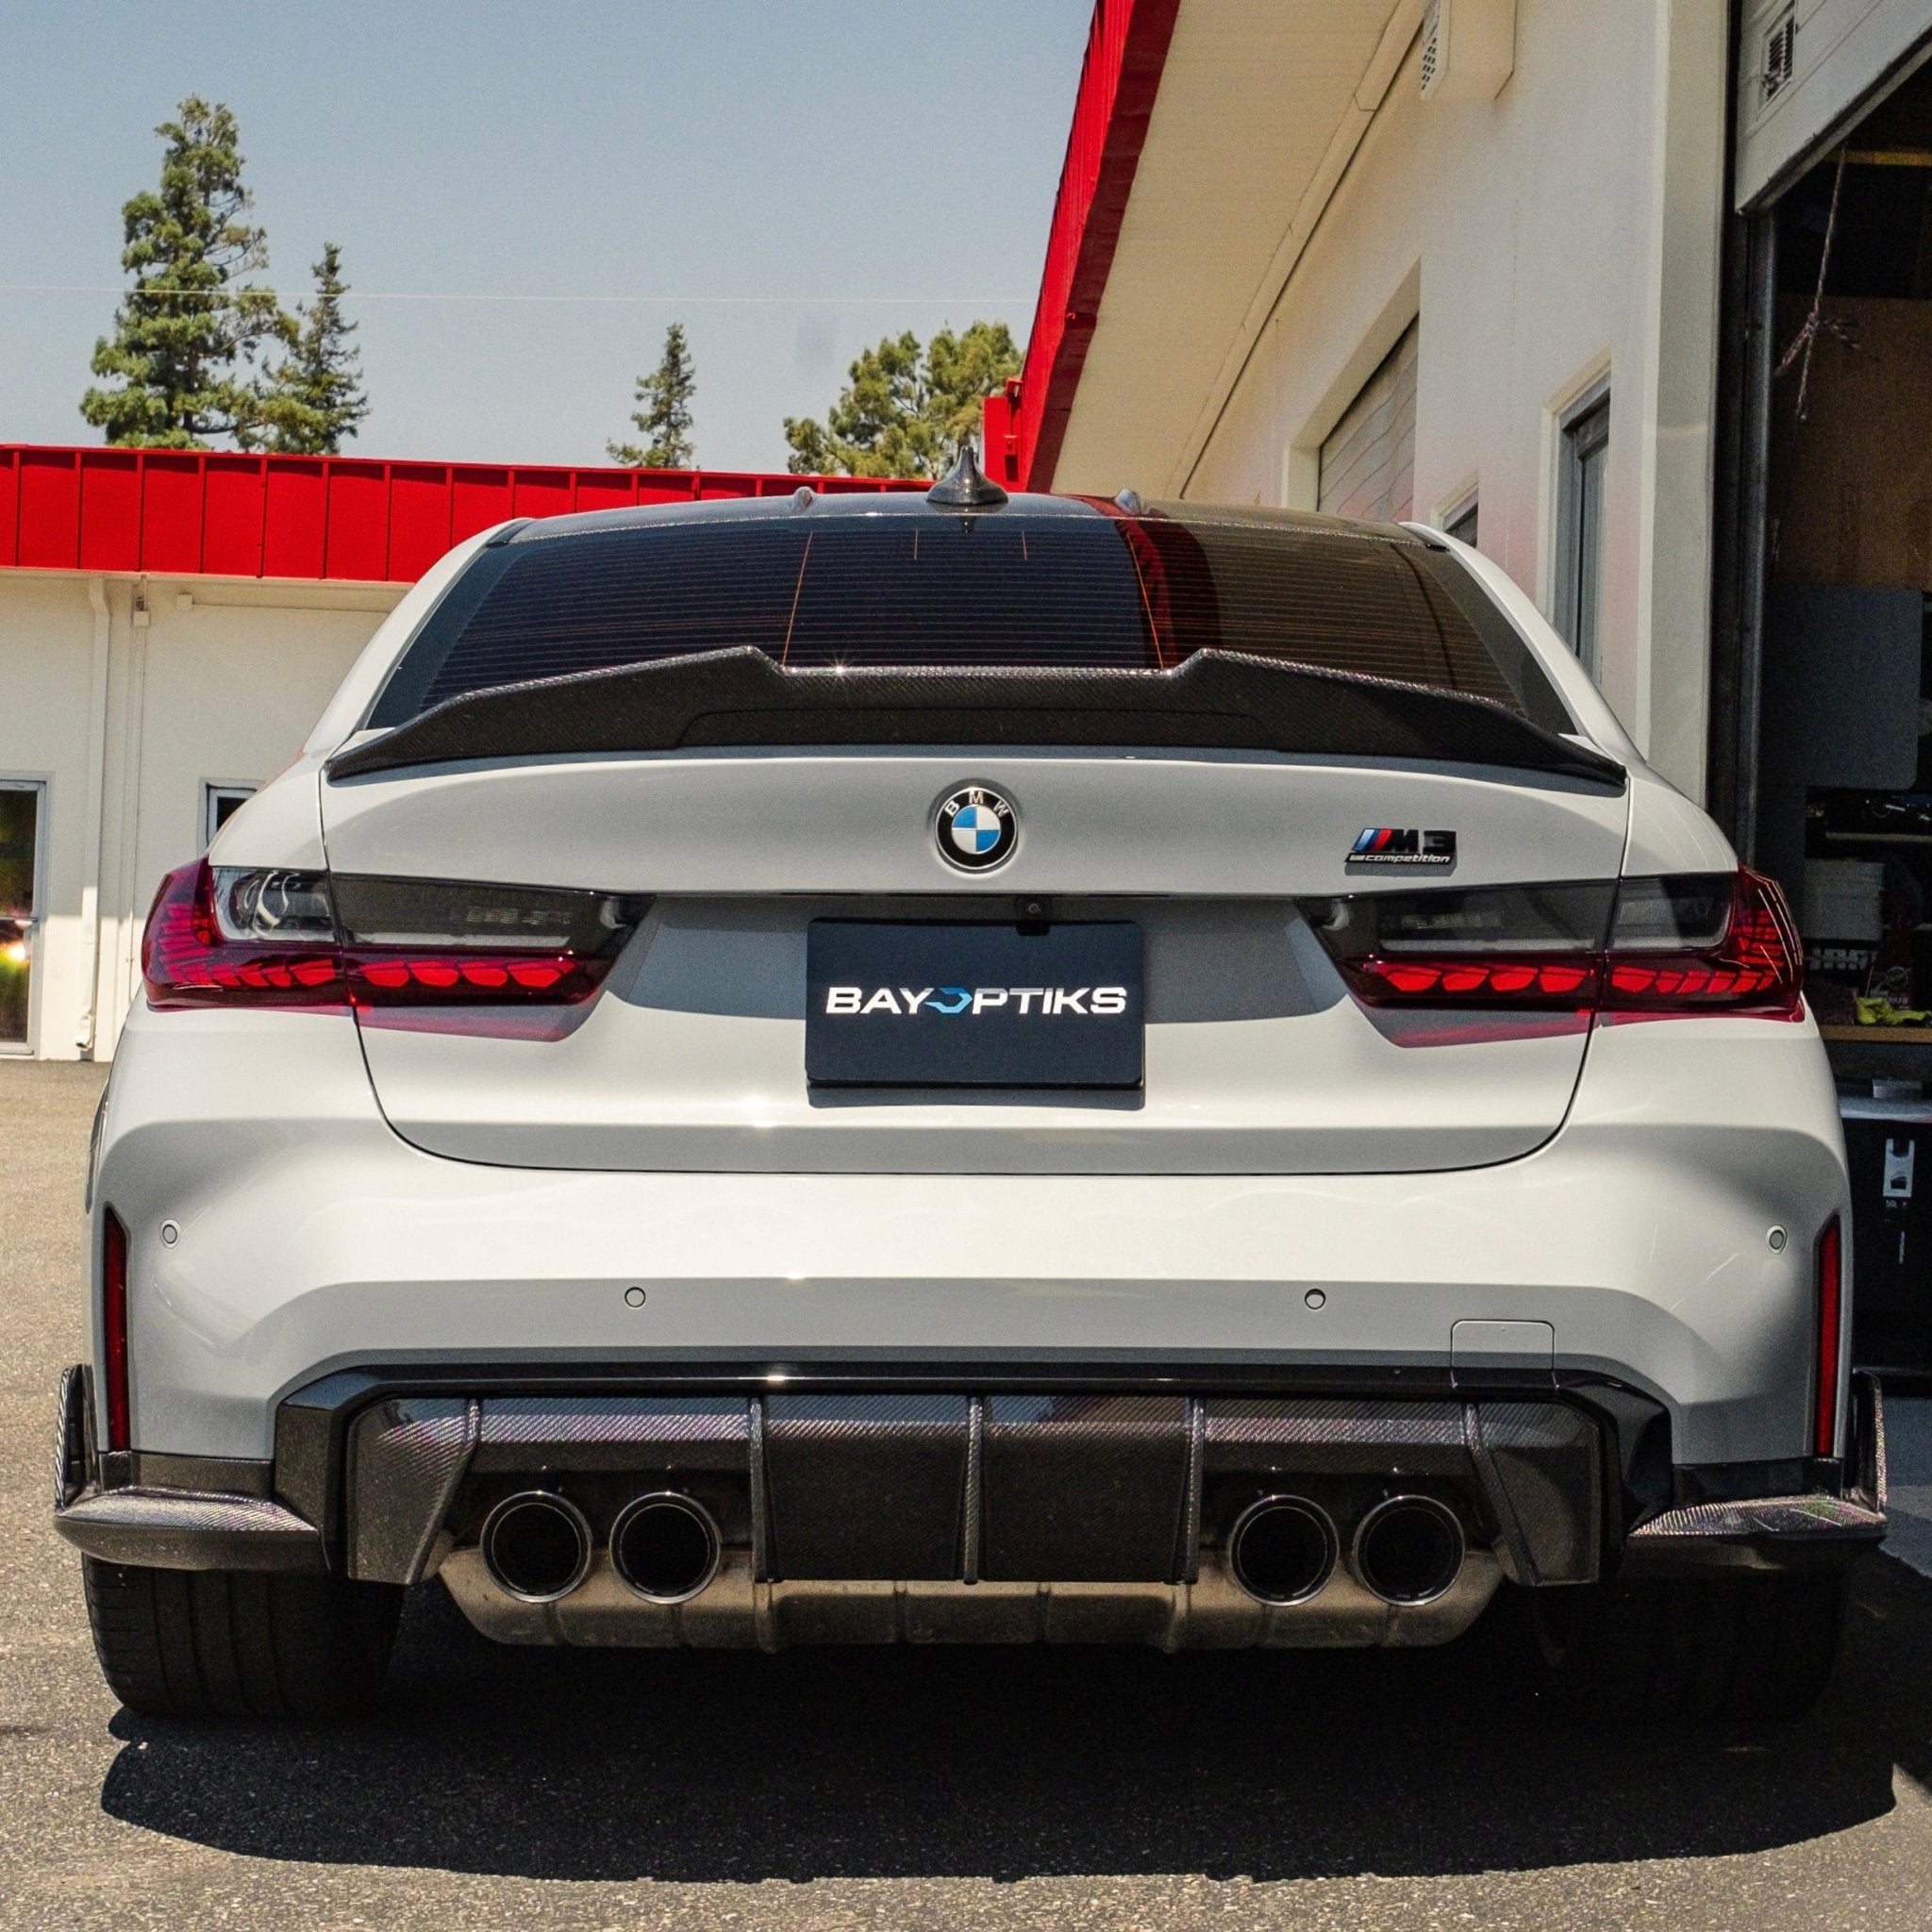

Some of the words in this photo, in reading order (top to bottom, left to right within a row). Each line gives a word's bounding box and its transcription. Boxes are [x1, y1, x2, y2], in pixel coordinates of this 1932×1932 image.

[944, 791, 1008, 817] BMW
[1380, 828, 1457, 853] M3
[1365, 854, 1451, 863] competition
